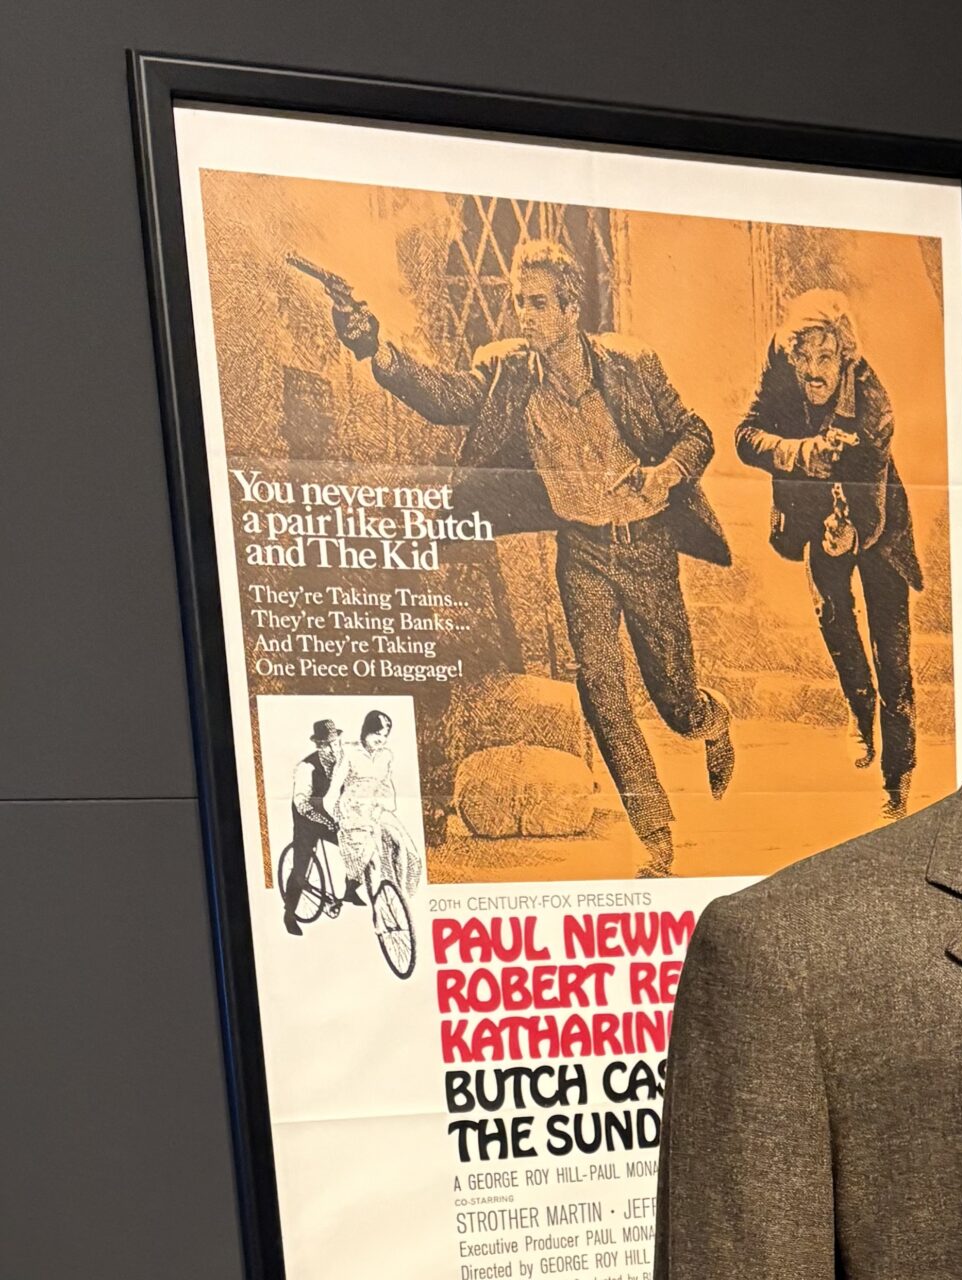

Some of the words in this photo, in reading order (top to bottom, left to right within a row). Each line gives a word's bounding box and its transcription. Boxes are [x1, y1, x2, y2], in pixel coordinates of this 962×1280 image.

[230, 470, 294, 503] You
[302, 482, 389, 508] never
[394, 484, 454, 510] met
[244, 512, 262, 533] a
[268, 506, 330, 540] pair
[336, 508, 396, 538] like
[401, 509, 494, 541] Butch
[246, 538, 306, 566] and
[308, 538, 376, 568] The
[381, 540, 439, 570] Kid
[326, 586, 391, 610] Taking
[395, 588, 468, 606] Trains...
[329, 612, 394, 634] Taking
[401, 614, 470, 631] Banks...
[254, 635, 292, 652] And
[372, 636, 436, 657] Taking
[256, 659, 295, 676] One
[300, 658, 348, 676] Piece
[353, 660, 376, 677] Of
[380, 660, 463, 682] Baggage!
[429, 899, 461, 912] 20TH
[467, 895, 572, 911] CENTURY-FOX
[578, 892, 651, 908] PRESENTS
[432, 916, 550, 964] PAUL
[564, 910, 696, 959] NEWM
[437, 963, 615, 1014] ROBERT
[630, 961, 684, 1005] RE
[445, 1064, 588, 1113] BUTCH
[448, 1116, 538, 1162] THE
[547, 1108, 661, 1156] SUND
[454, 1176, 461, 1192] A
[468, 1171, 518, 1191] GEORGE
[526, 1169, 549, 1186] ROY
[557, 1164, 620, 1184] HILL-PAUL
[626, 1161, 658, 1178] MONA
[455, 1195, 514, 1207] CO-STARRING
[457, 1207, 539, 1234] STROTHER
[547, 1202, 602, 1227] MARTIN
[460, 1241, 518, 1258] Executive
[525, 1234, 579, 1252] Producer
[586, 1229, 616, 1246] PAUL
[623, 1225, 655, 1243] MONA
[461, 1261, 512, 1280] Directed
[520, 1261, 533, 1279] by
[541, 1254, 589, 1274] GEORGE
[595, 1252, 618, 1269] ROY
[625, 1249, 650, 1266] HILL
